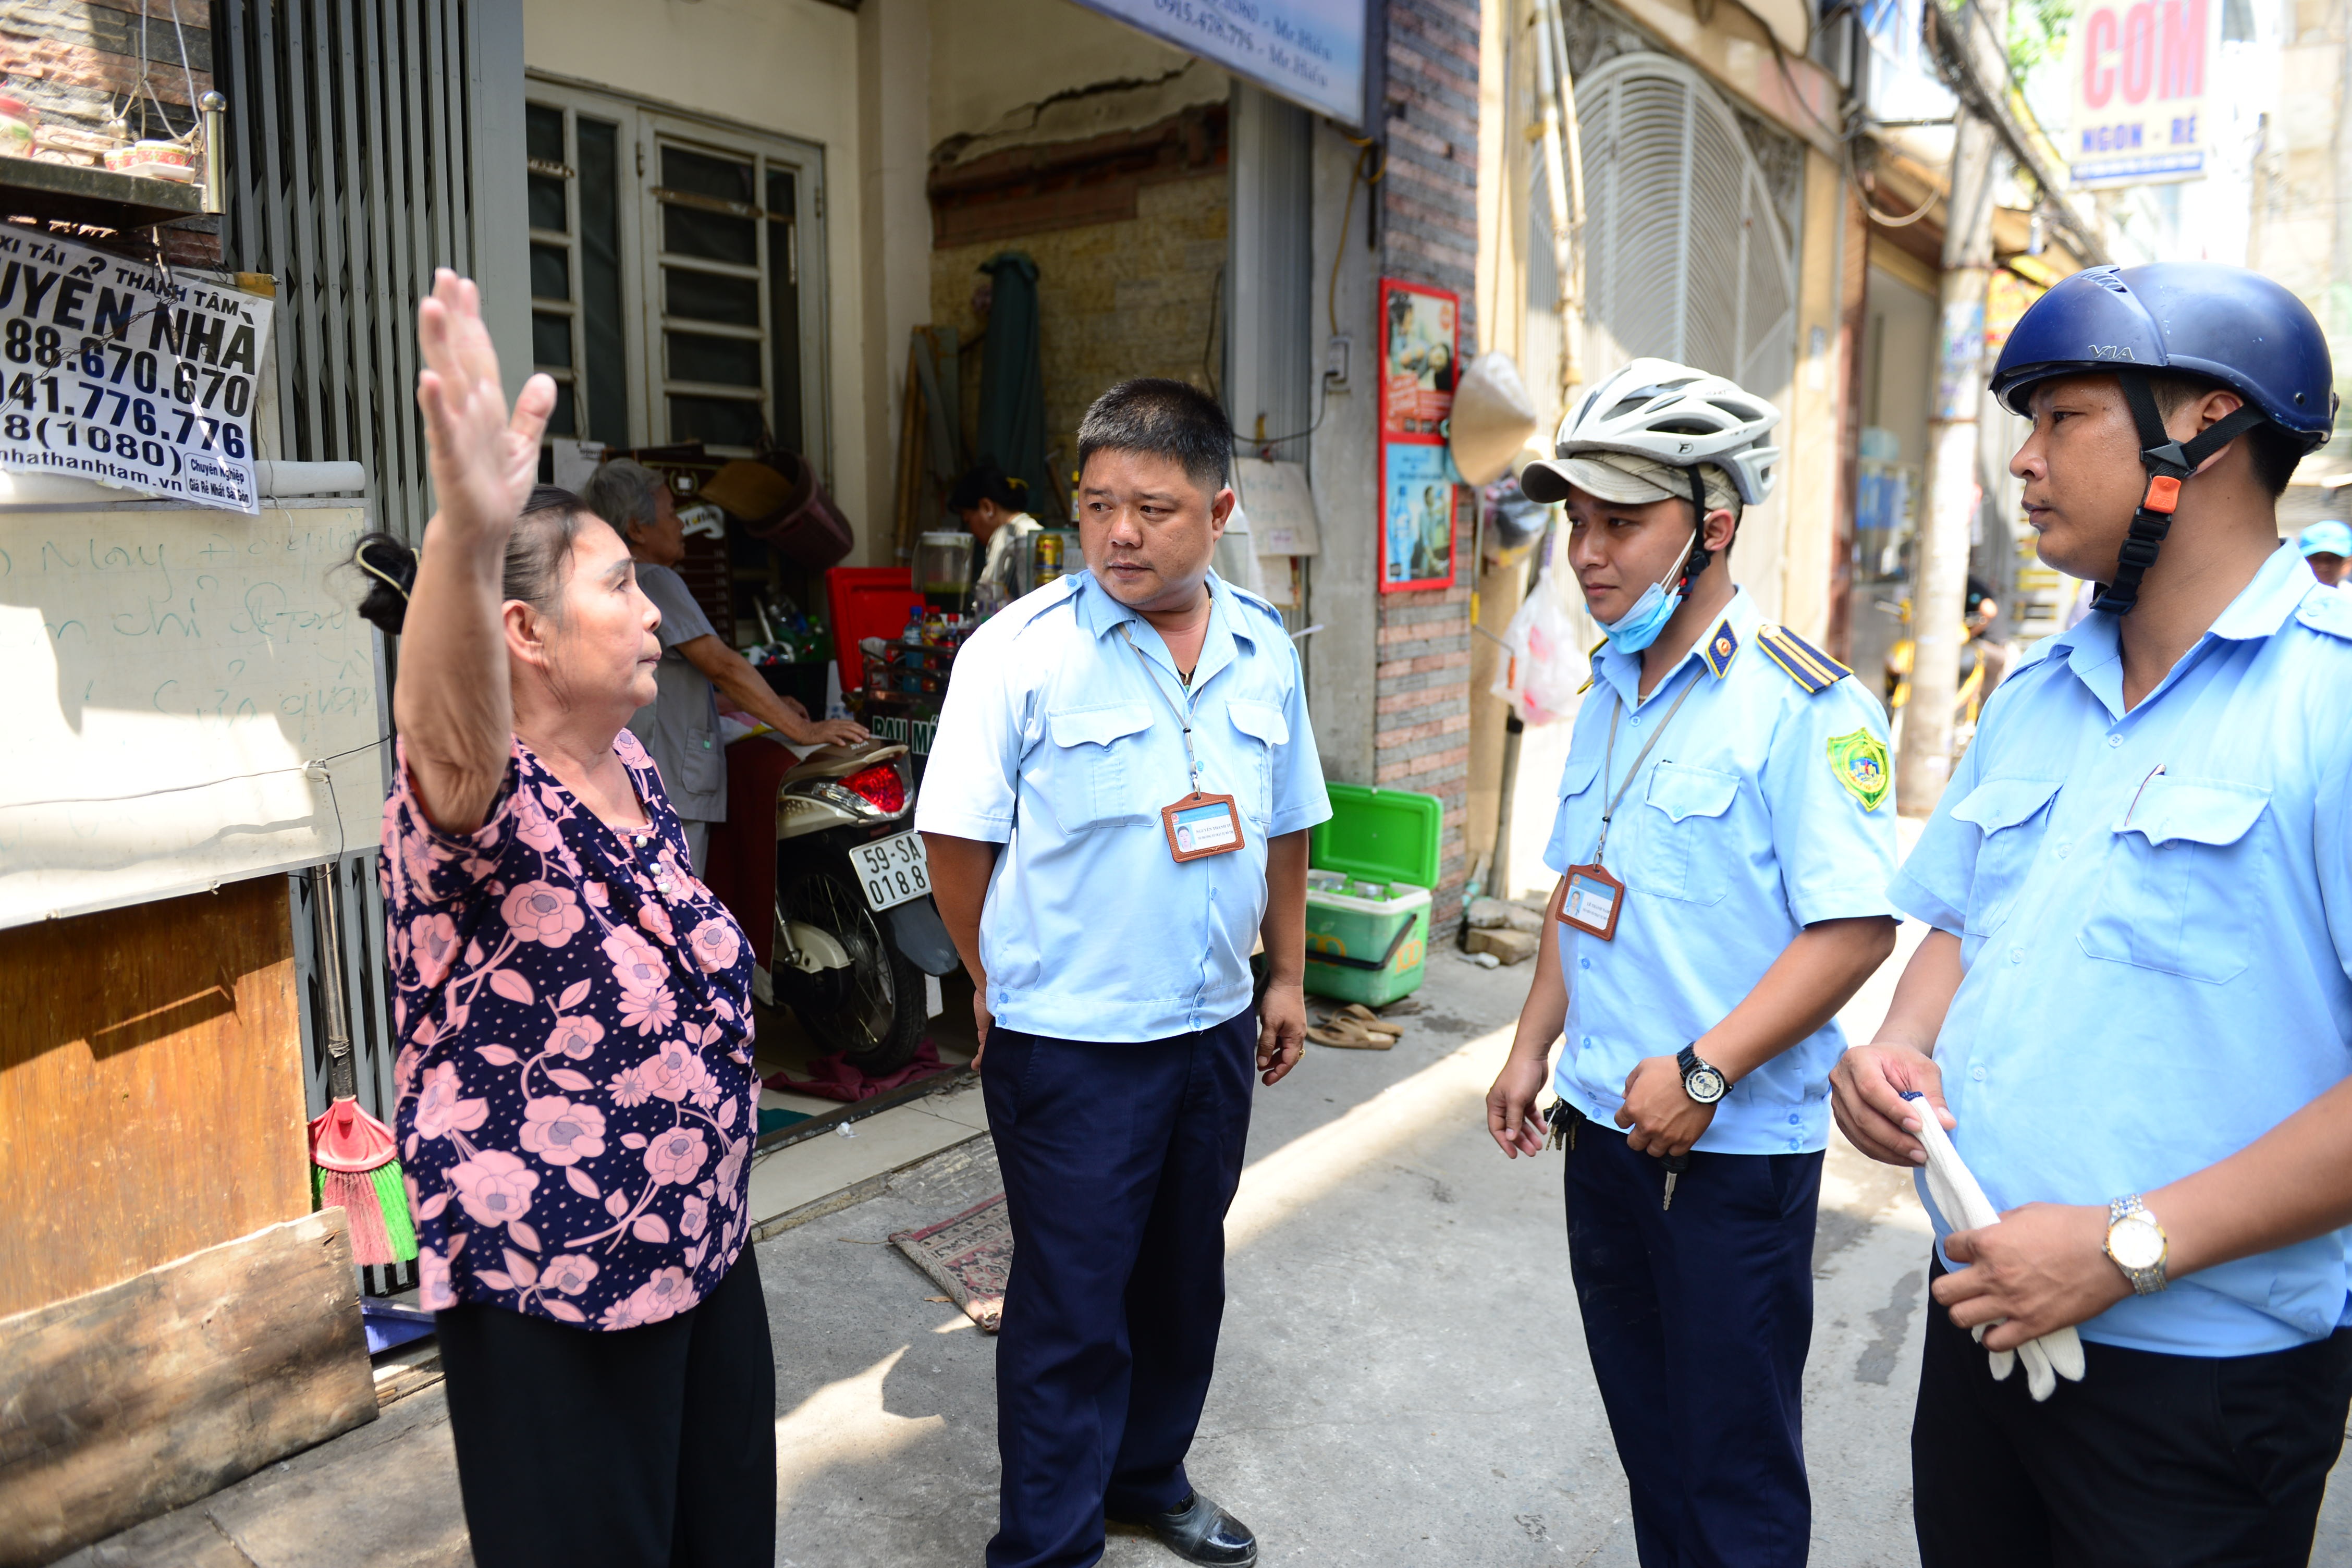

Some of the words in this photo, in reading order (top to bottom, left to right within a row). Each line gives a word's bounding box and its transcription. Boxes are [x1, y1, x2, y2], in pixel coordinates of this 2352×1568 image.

[2082, 121, 2144, 152] NGON
[28, 243, 66, 266] TẢI
[194, 290, 239, 316] TÂM
[149, 303, 255, 375] NHÀ
[2088, 345, 2135, 361] VIA
[0, 369, 245, 458] 41.776.776
[189, 478, 199, 492] Giá
[201, 480, 209, 494] Rẻ
[211, 483, 225, 497] Nhất
[191, 458, 218, 476] Chuyên
[219, 464, 244, 485] Nghiệp
[863, 836, 922, 874] 59-SA
[869, 863, 928, 904] 018.8
